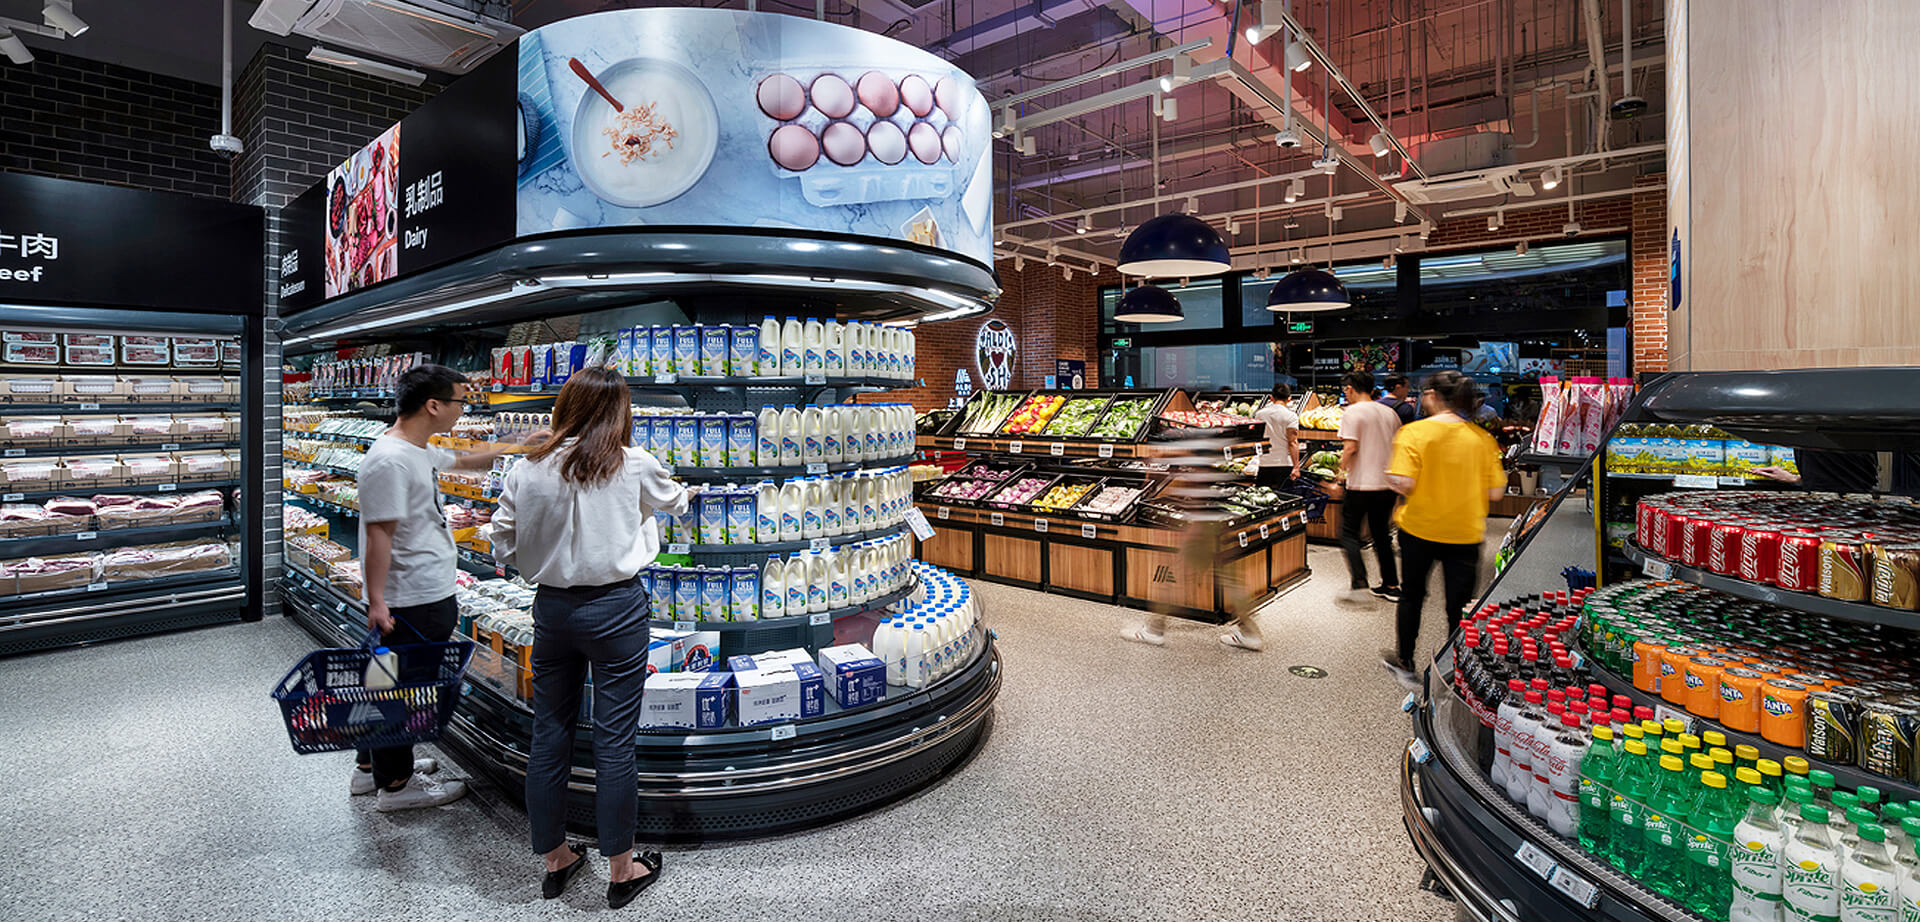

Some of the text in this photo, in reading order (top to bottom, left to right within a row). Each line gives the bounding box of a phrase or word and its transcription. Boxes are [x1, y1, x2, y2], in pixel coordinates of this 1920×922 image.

[405, 170, 444, 219] 乳制品
[404, 226, 428, 250] Dairy
[0, 266, 43, 282] eef
[1821, 548, 1833, 593] Watson's
[1763, 699, 1793, 716] FANTA
[1810, 707, 1827, 756] Watson's
[1732, 847, 1773, 864] Sprite
[1785, 865, 1830, 885] Sprite
